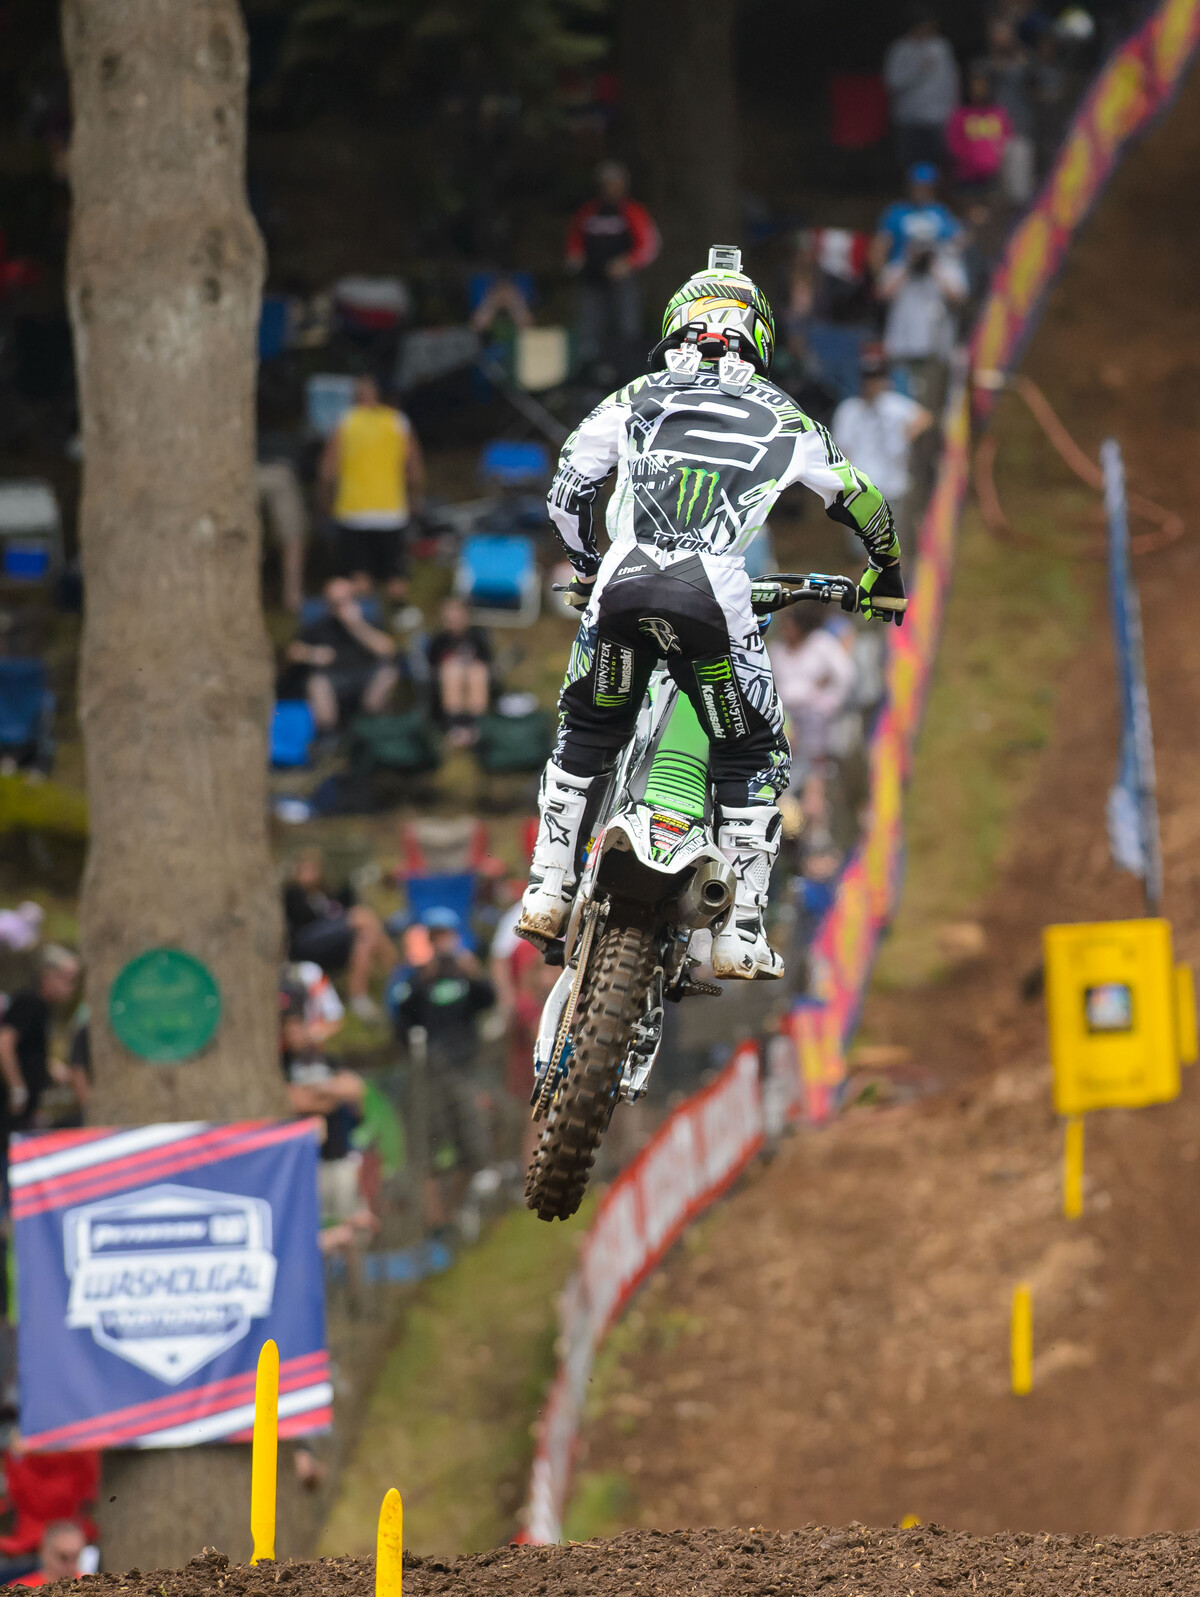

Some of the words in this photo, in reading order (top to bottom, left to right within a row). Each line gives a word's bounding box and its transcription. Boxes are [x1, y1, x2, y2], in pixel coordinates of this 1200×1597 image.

[645, 387, 784, 472] 2
[617, 564, 648, 576] thor
[596, 642, 612, 693] MONSTER
[609, 655, 617, 686] ENERGY
[617, 648, 632, 694] Kawasaki
[701, 684, 726, 738] Kawasaki
[719, 694, 732, 729] ENERGY
[723, 681, 746, 738] MONSTER
